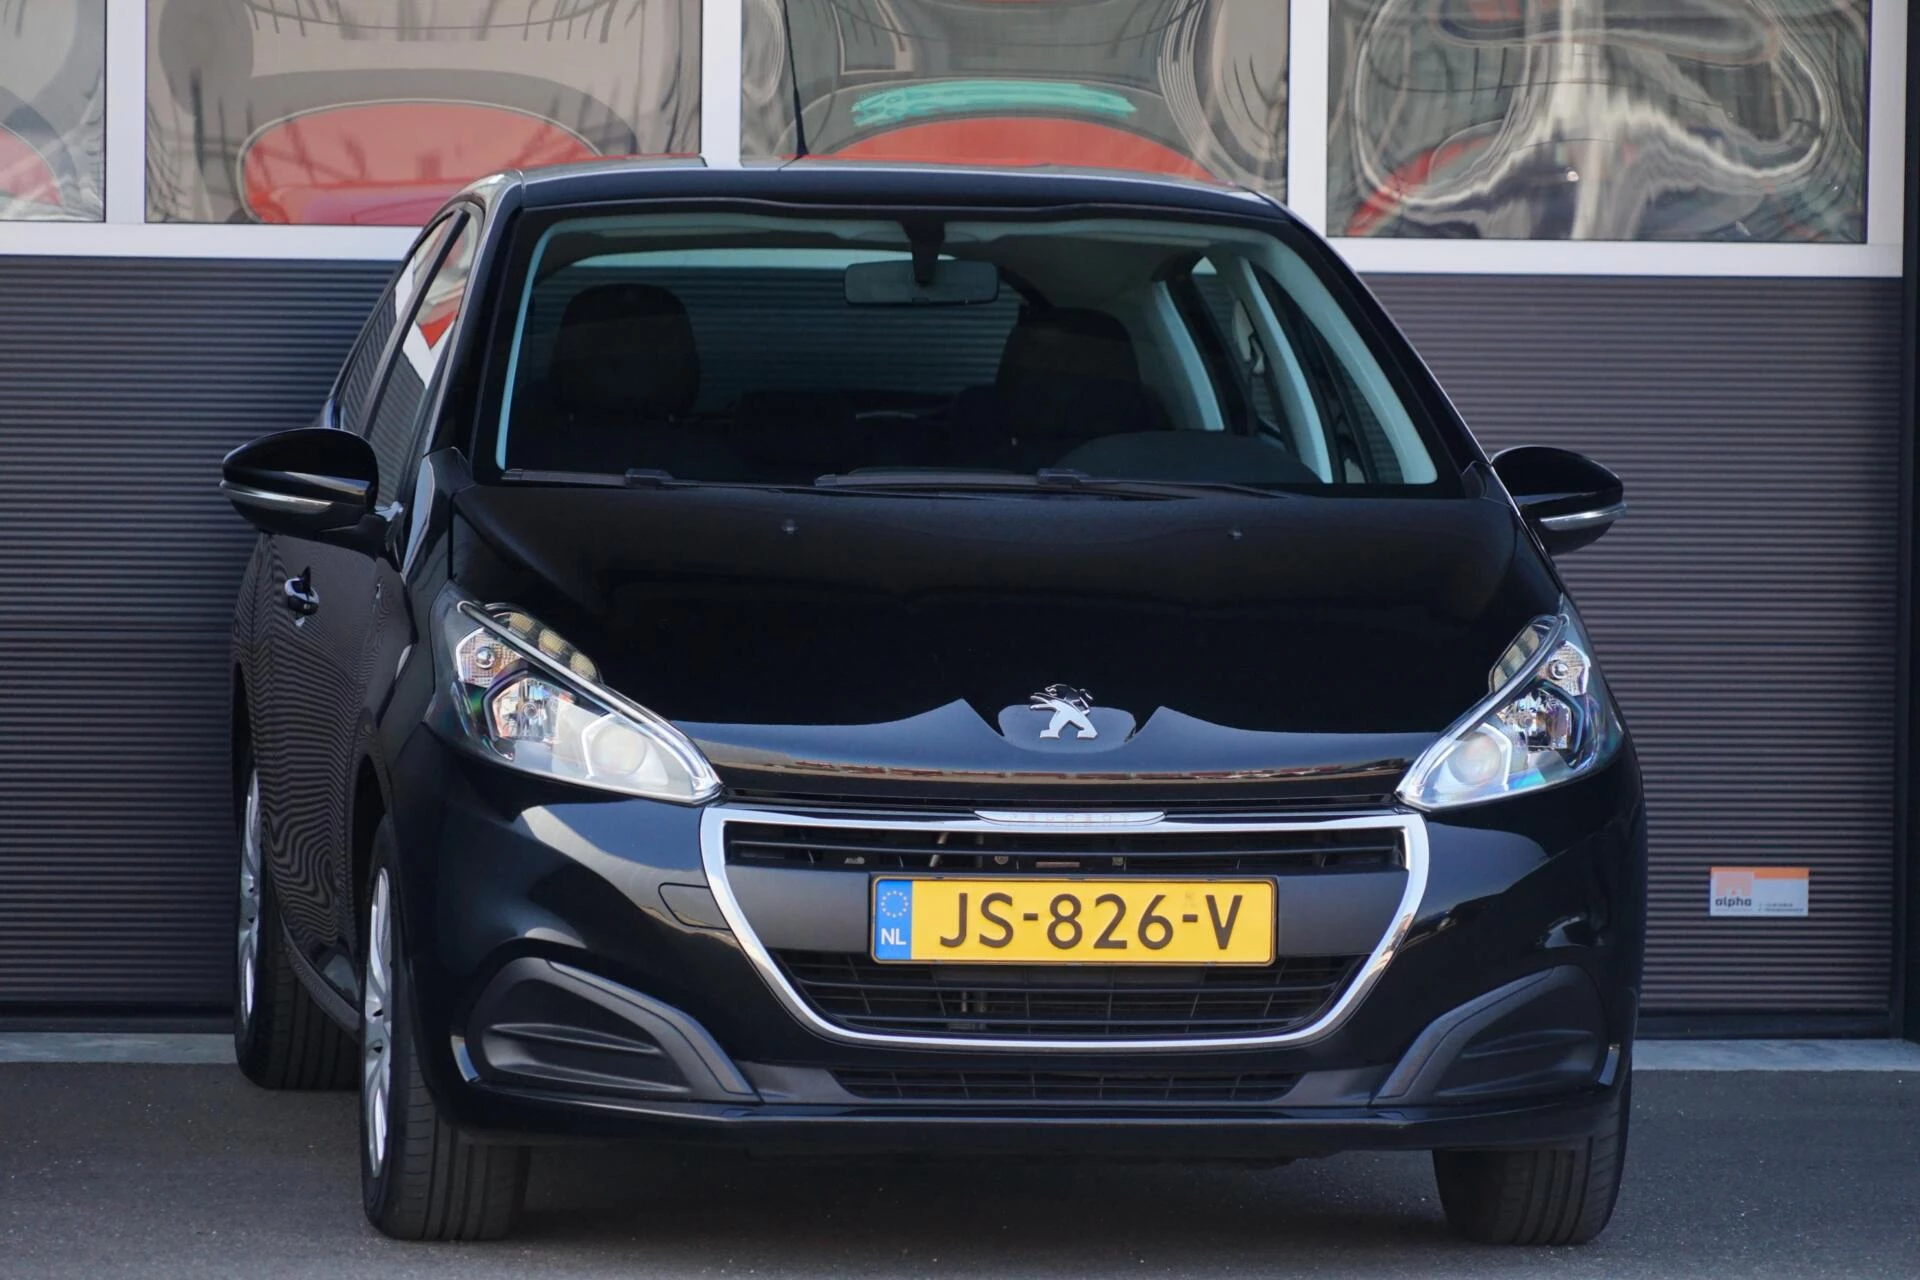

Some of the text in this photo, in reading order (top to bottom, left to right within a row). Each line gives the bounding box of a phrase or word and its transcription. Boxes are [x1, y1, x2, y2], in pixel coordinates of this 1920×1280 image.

[1715, 896, 1752, 909] alpha
[939, 892, 1244, 950] JS-826-V
[881, 928, 906, 945] NL
